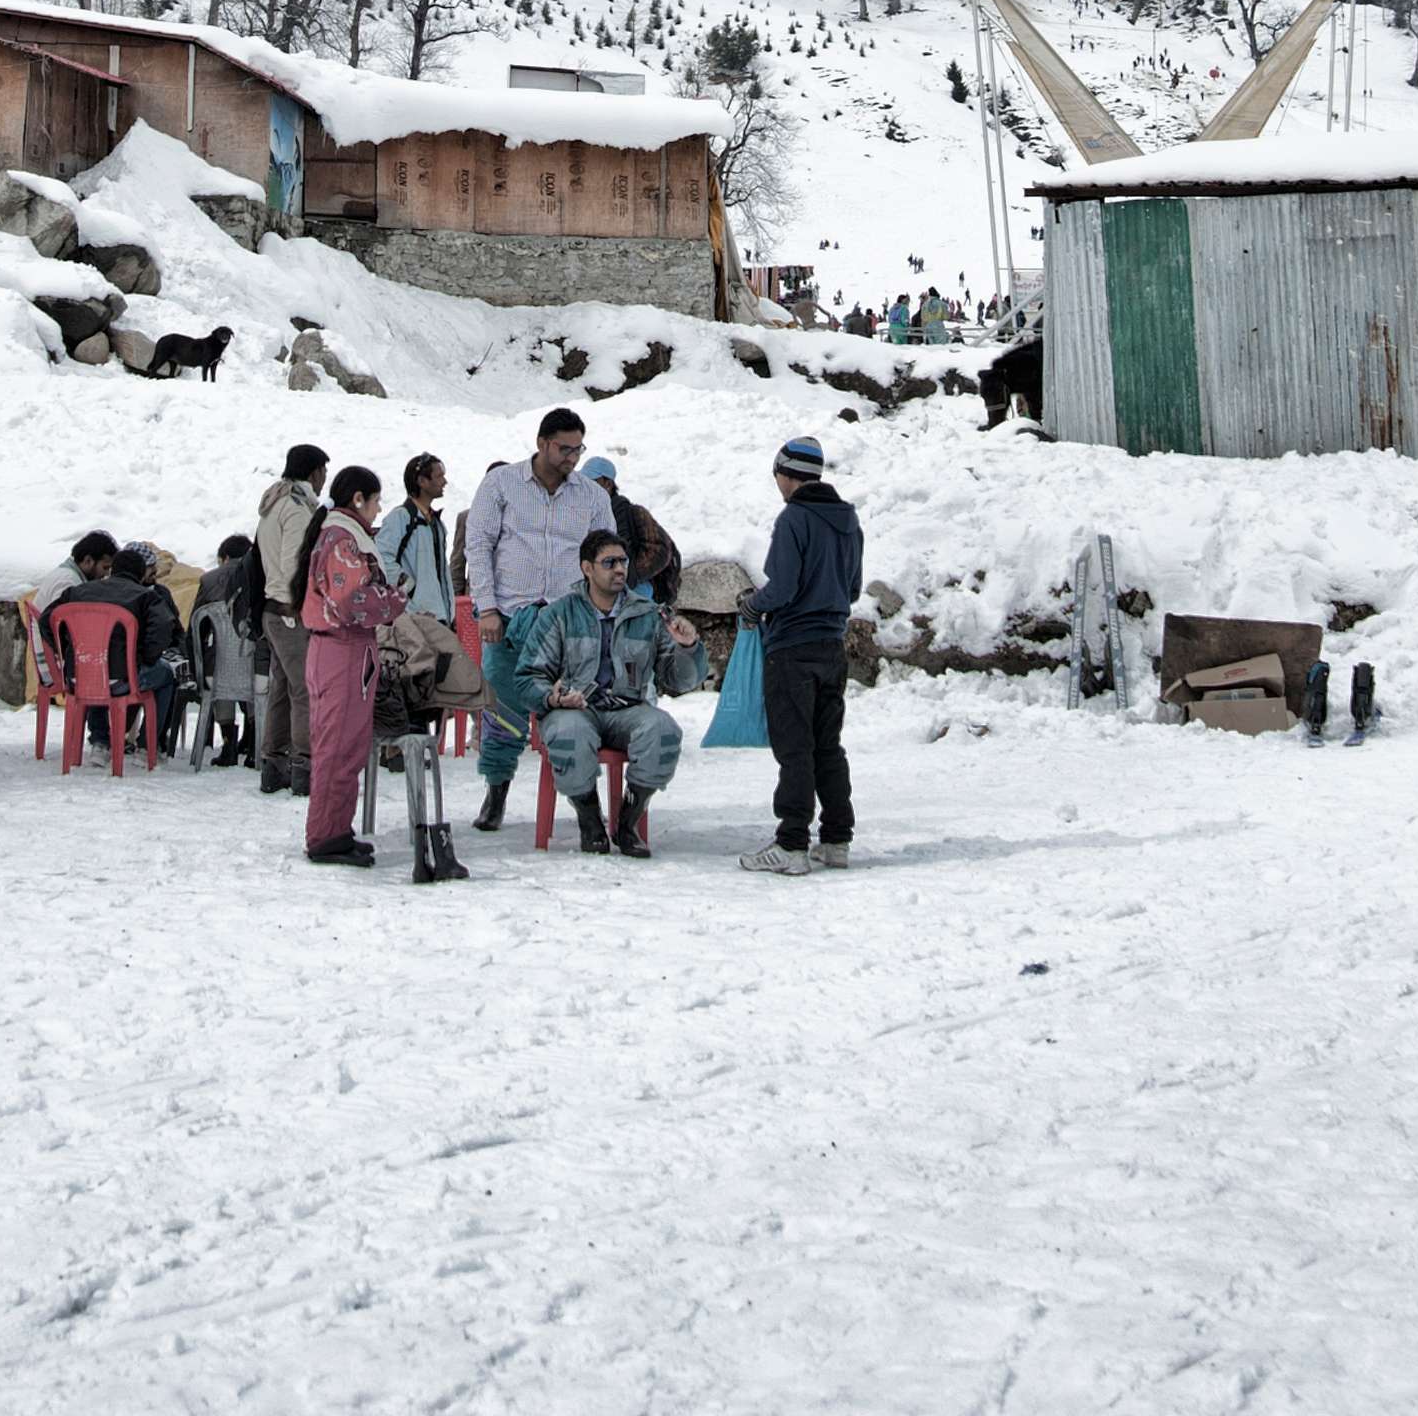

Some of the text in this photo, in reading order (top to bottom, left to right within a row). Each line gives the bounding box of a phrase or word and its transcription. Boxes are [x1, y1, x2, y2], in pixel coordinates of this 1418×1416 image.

[398, 160, 407, 187] ICON
[460, 168, 469, 195] ICON
[546, 171, 555, 198] ICON
[619, 174, 628, 200] ICON
[689, 178, 699, 205] ICON
[1102, 542, 1113, 583] BLIZZARD
[1109, 607, 1120, 649] BLIZZARD
